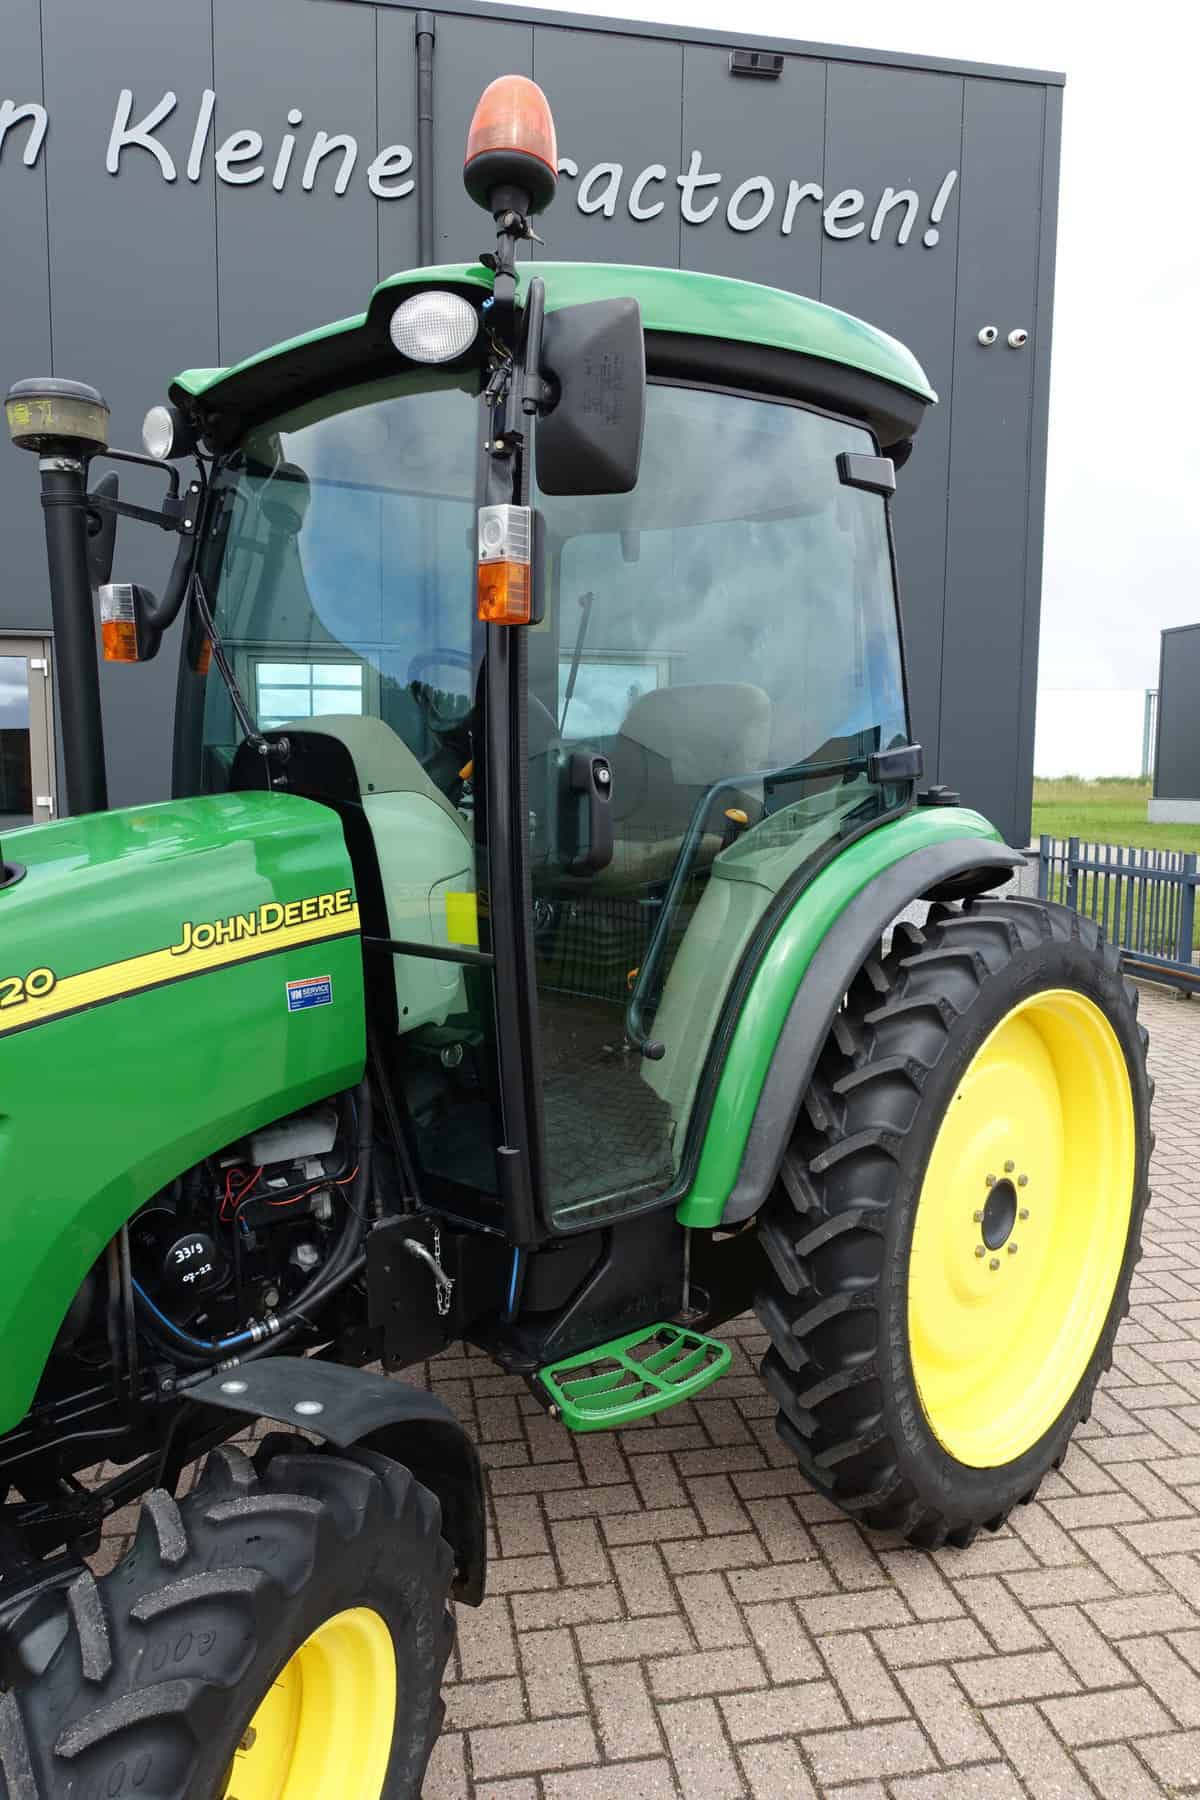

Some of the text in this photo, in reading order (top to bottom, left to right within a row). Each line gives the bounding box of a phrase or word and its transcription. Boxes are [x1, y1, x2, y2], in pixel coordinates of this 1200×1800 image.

[105, 88, 416, 199] Kleine
[170, 888, 352, 956] JOHN DEERE
[175, 1242, 204, 1264] 3319
